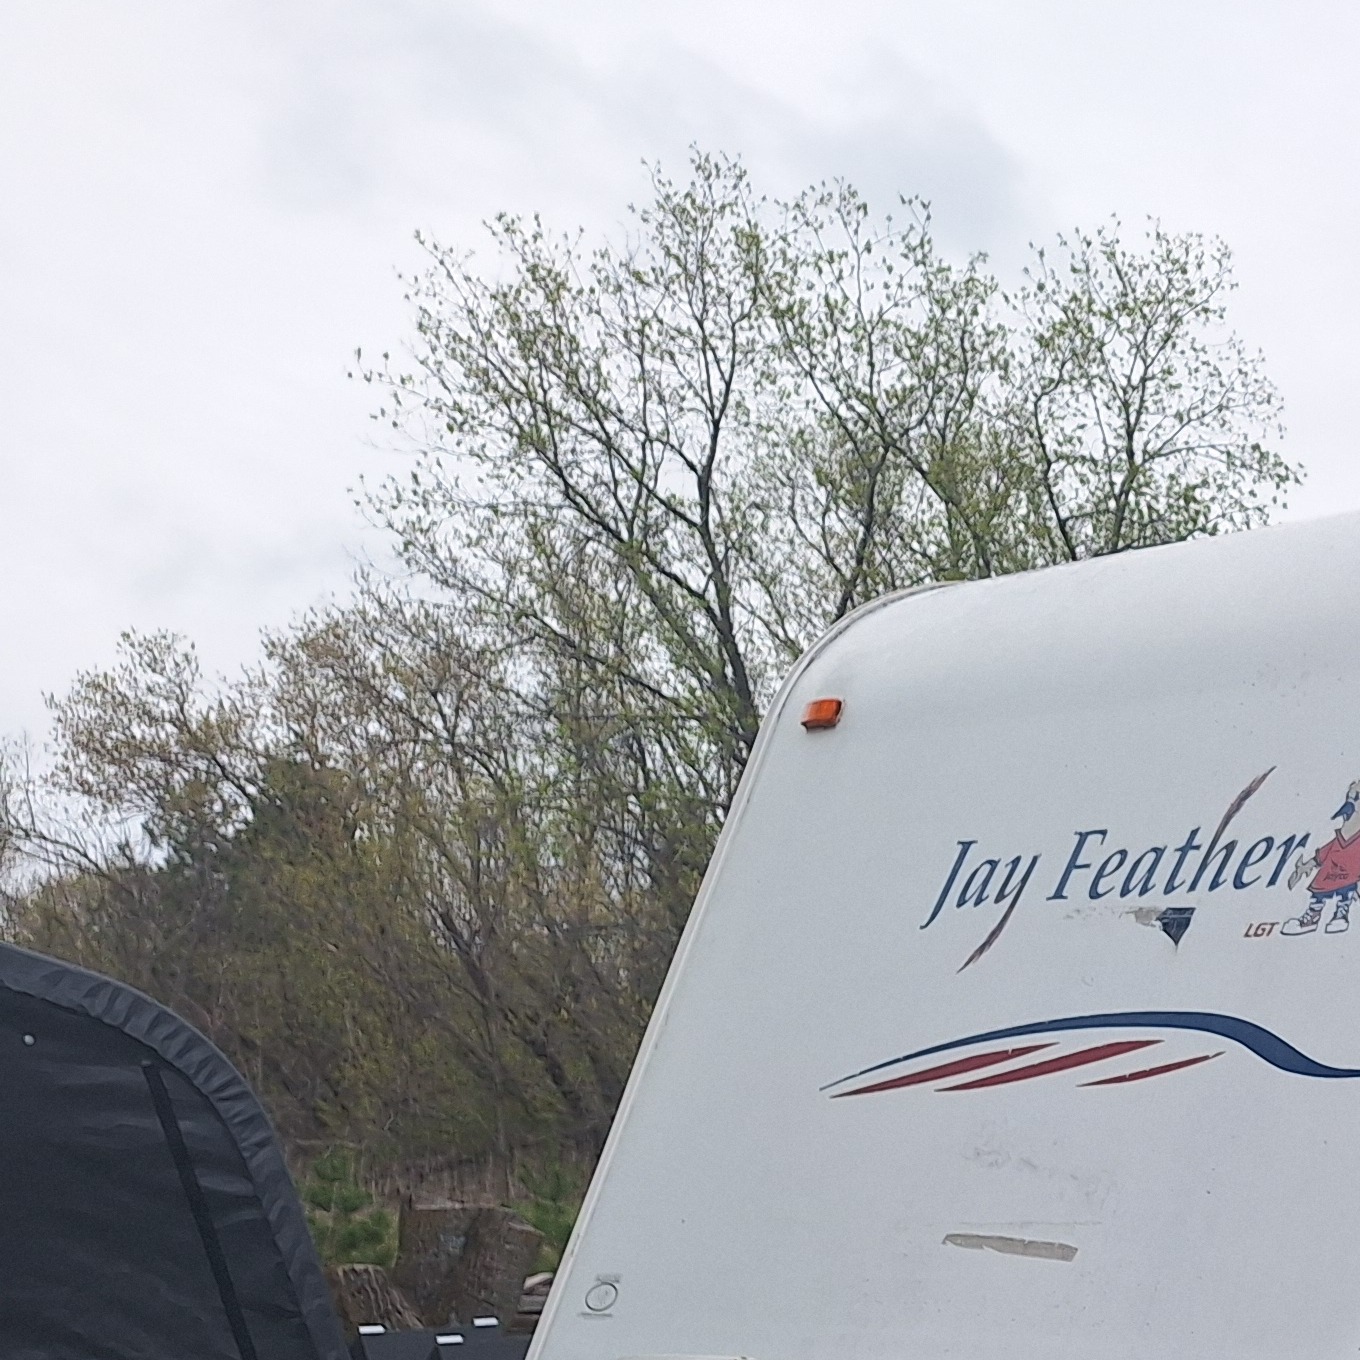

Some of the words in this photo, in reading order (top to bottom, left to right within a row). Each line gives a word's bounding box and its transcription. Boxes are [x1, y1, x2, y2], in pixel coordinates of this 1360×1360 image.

[919, 839, 1043, 974] Jay
[1045, 765, 1312, 902] Feather
[1243, 921, 1279, 939] LGT
